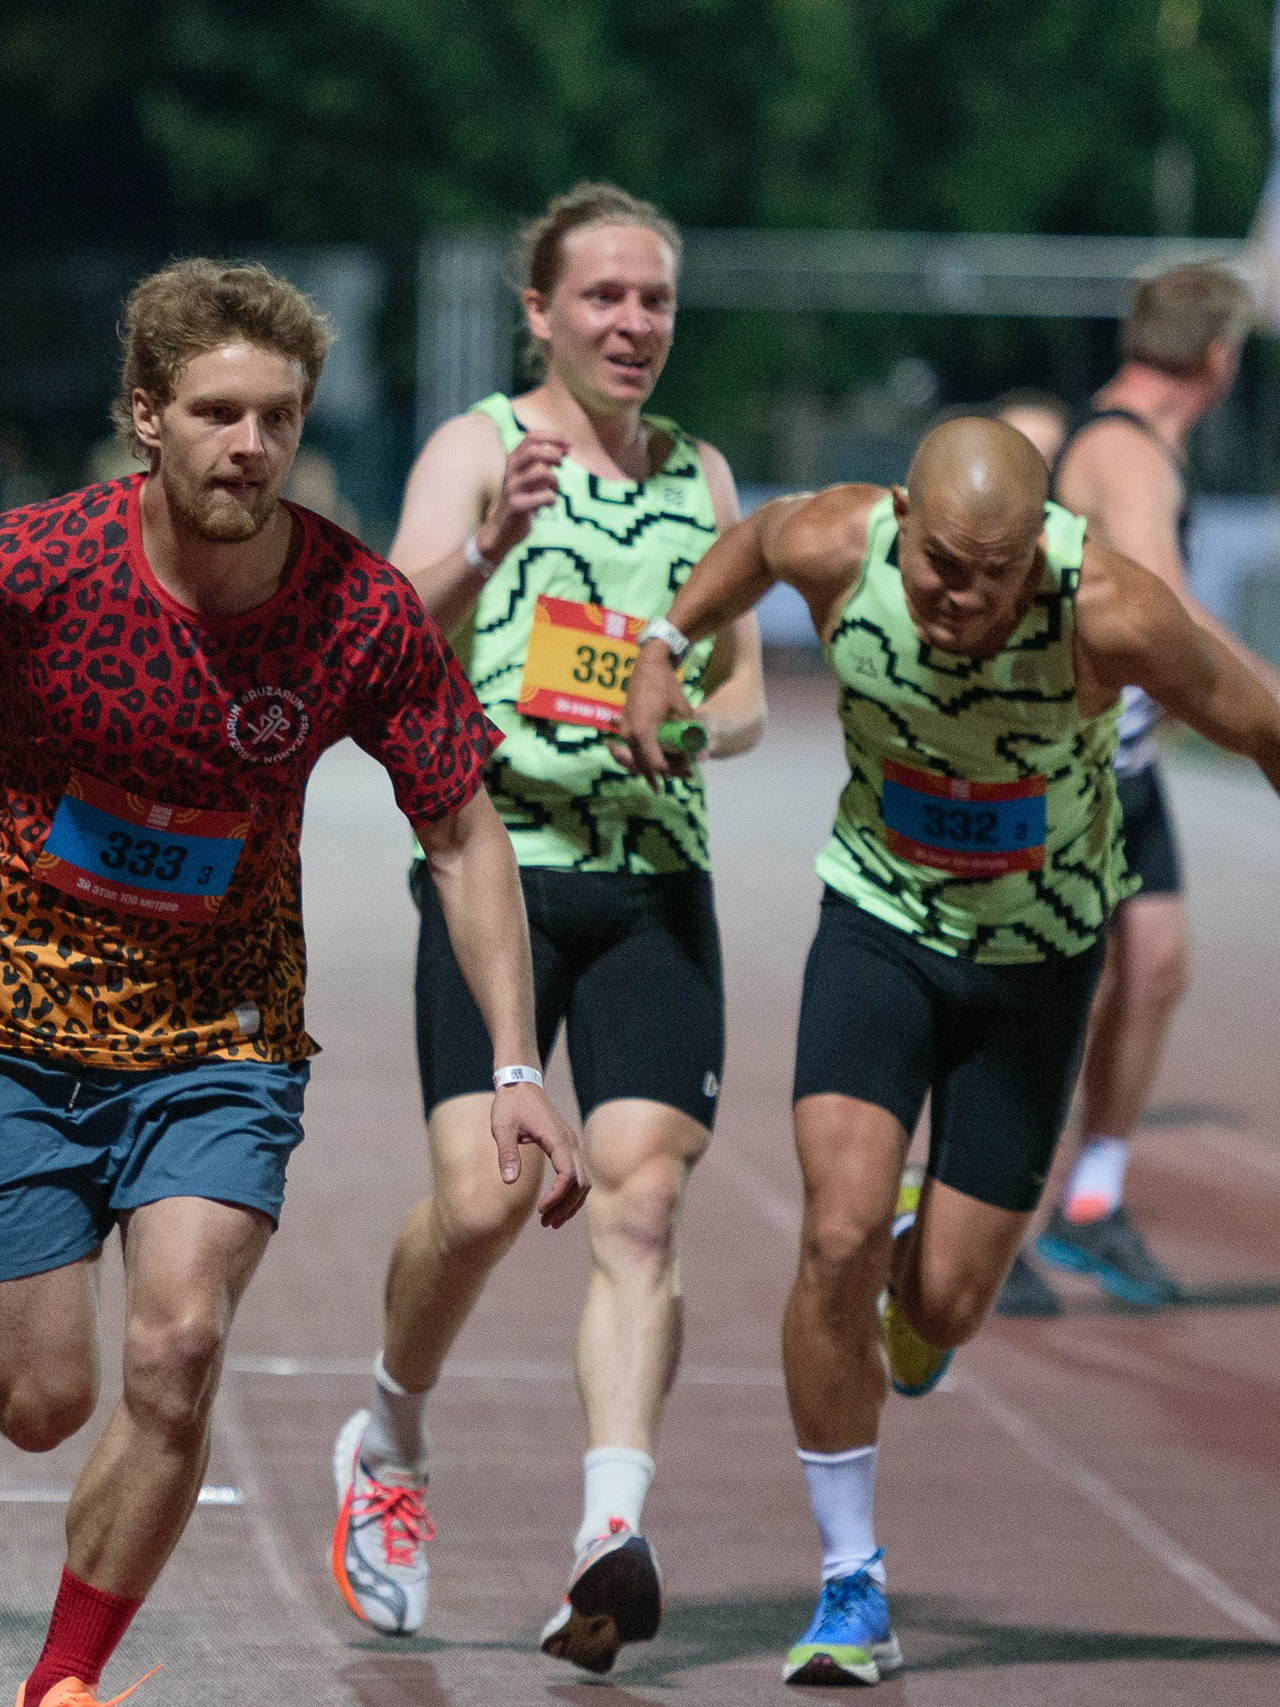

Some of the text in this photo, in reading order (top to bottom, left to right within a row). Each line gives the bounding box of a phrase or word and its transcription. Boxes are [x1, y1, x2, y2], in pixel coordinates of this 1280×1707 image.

[923, 804, 999, 845] 332
[99, 831, 214, 885] 333 3
